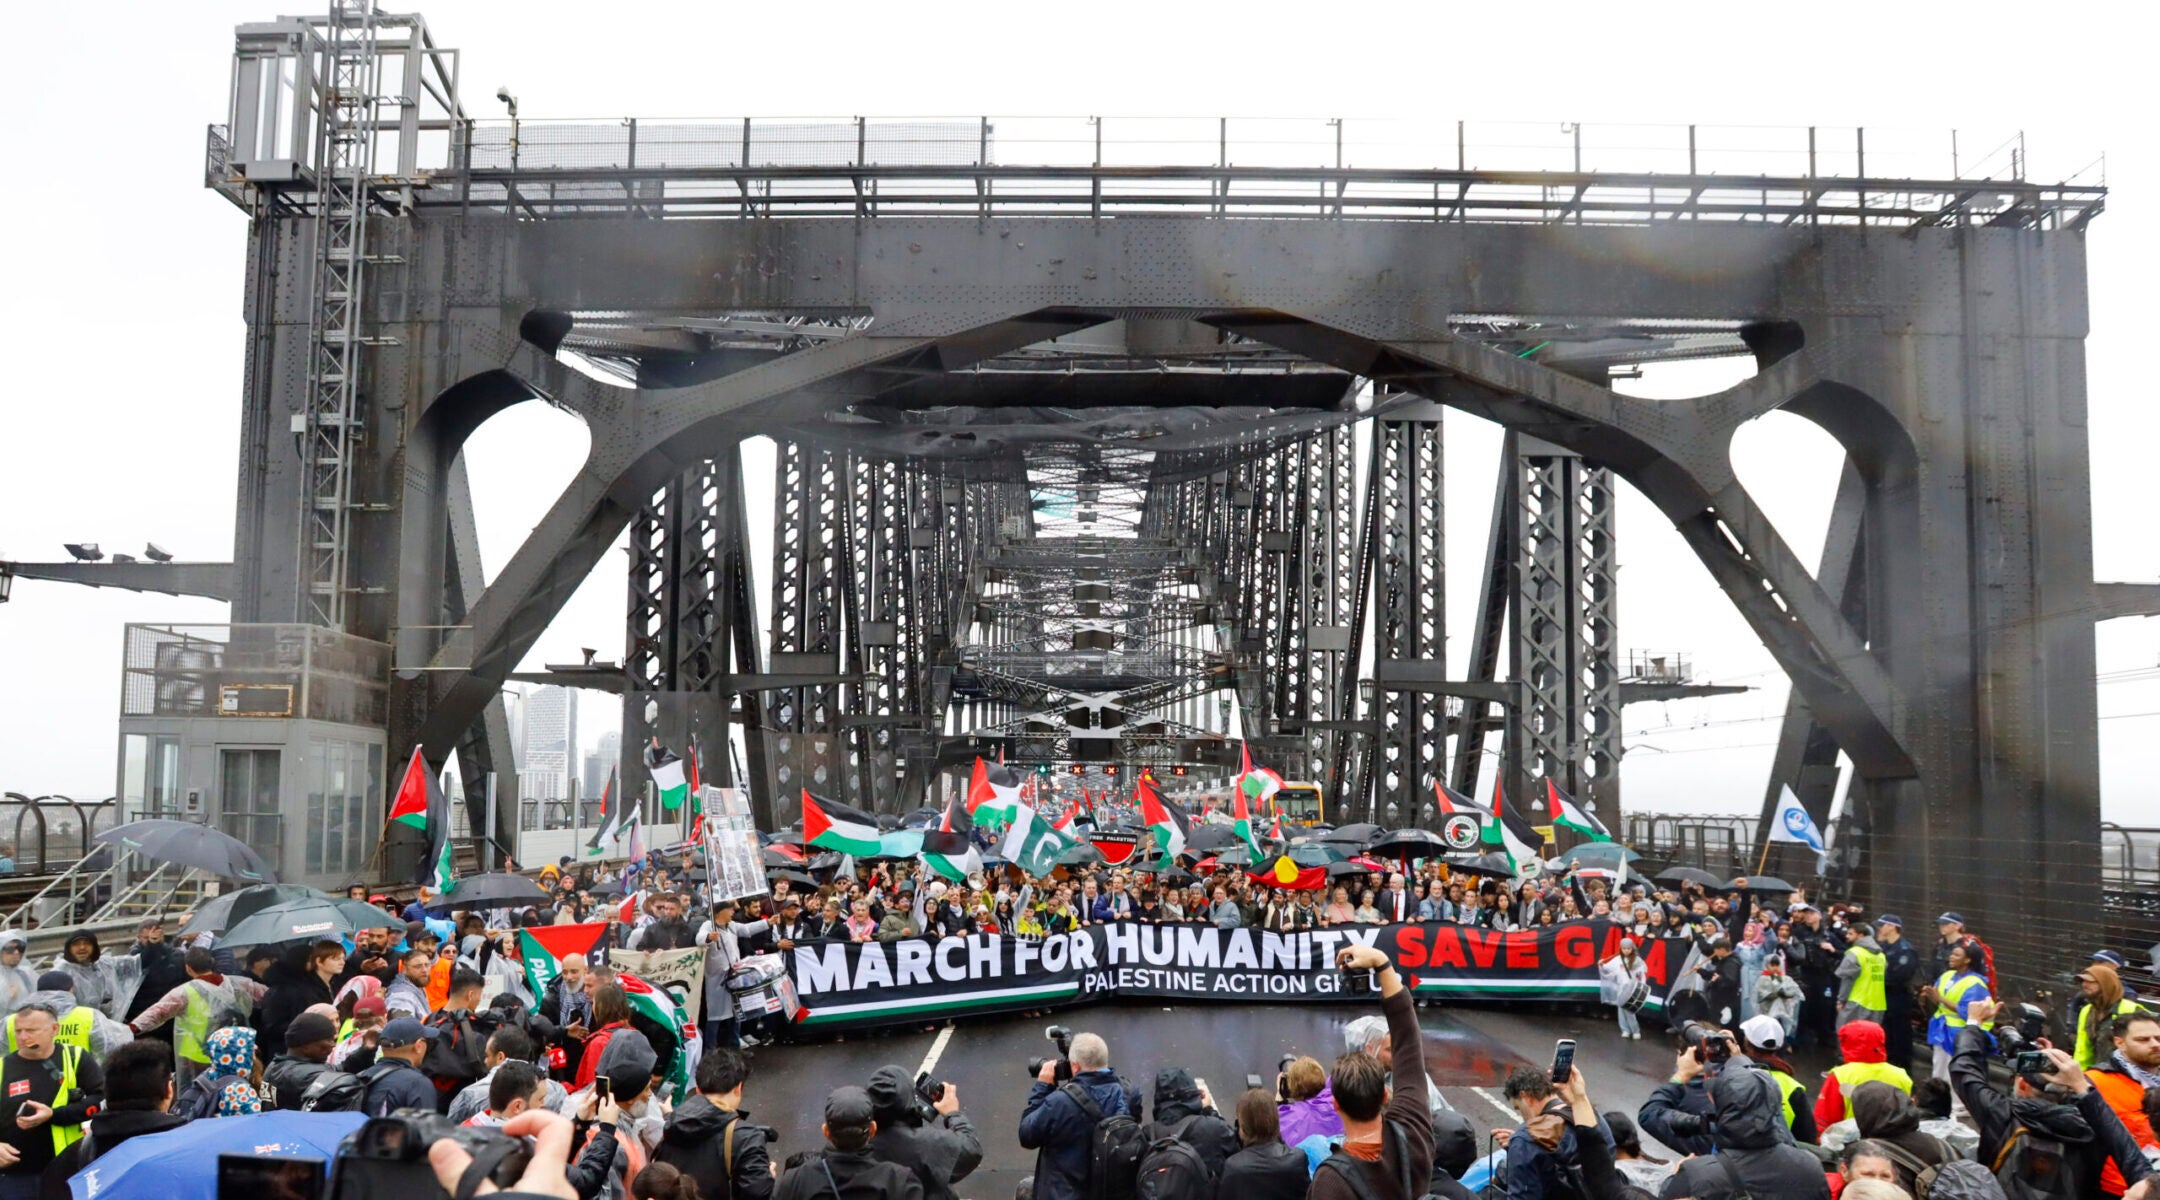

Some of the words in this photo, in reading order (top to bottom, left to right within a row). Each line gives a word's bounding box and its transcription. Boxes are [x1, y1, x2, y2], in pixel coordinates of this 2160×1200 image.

[794, 932, 1002, 995] MARCH
[1014, 930, 1098, 976] FOR
[1396, 925, 1539, 969] SAVE
[1084, 967, 1207, 994] PALESTINE
[1213, 972, 1307, 994] ACTION
